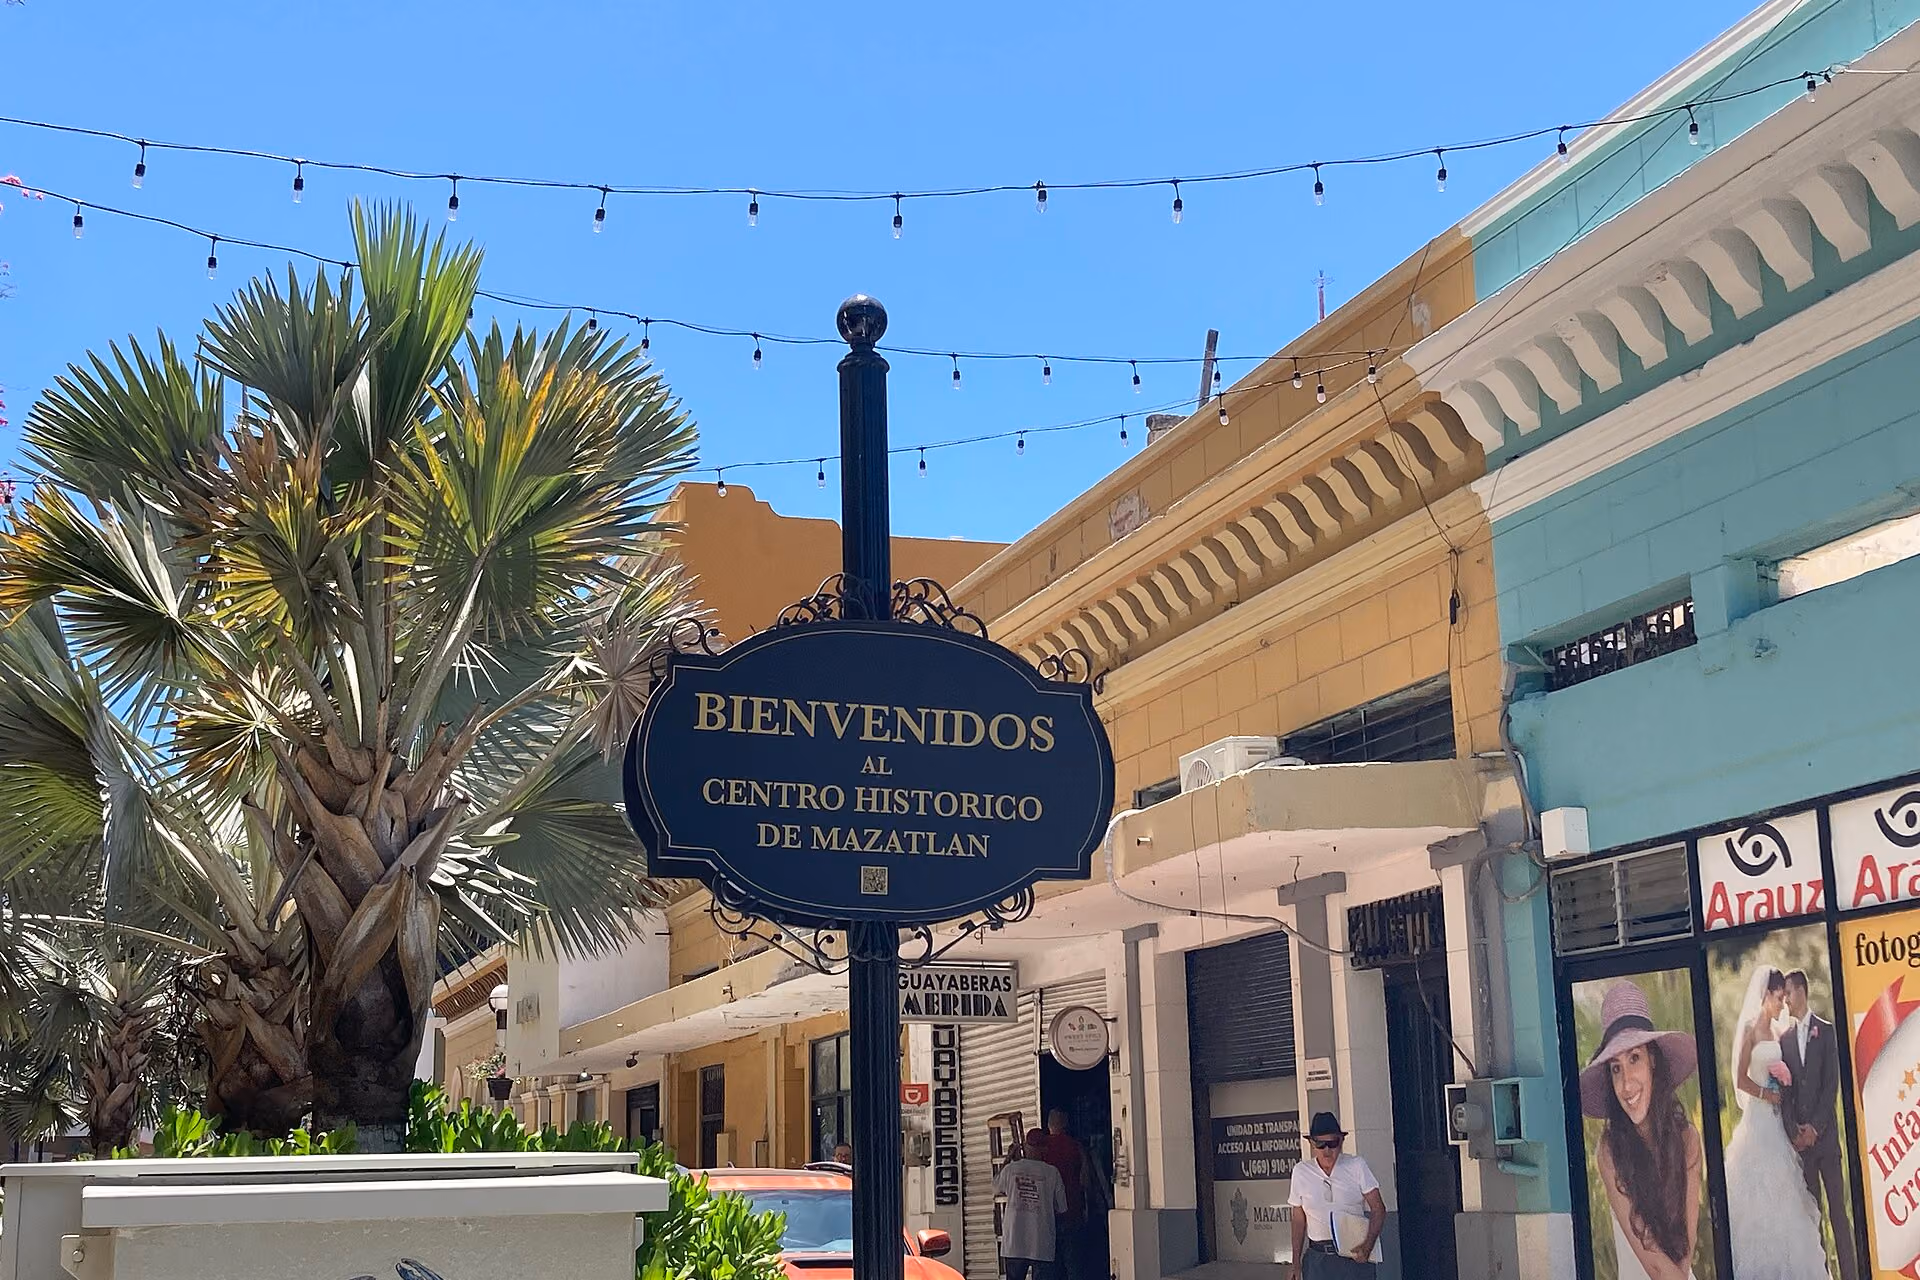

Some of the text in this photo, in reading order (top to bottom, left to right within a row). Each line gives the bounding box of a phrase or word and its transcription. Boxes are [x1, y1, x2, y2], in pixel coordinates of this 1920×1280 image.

[693, 692, 1055, 753] BIENVENIDOS
[860, 756, 893, 776] AL
[702, 778, 1043, 822] CENTRO HISTORICO
[756, 823, 990, 858] DE MAZATLAN
[1705, 880, 1825, 931] Arauz
[898, 972, 1012, 993] GUAYABERAS
[901, 992, 1008, 1017] MERIDA
[932, 1024, 960, 1206] UAYABERAS
[1226, 1120, 1300, 1136] UNIDAD DE TRANSPA
[1217, 1142, 1244, 1155] ACCESO
[1244, 1141, 1251, 1153] A
[1251, 1140, 1261, 1153] LA
[1868, 1098, 1920, 1181] Infa
[1249, 1159, 1270, 1176] (669)
